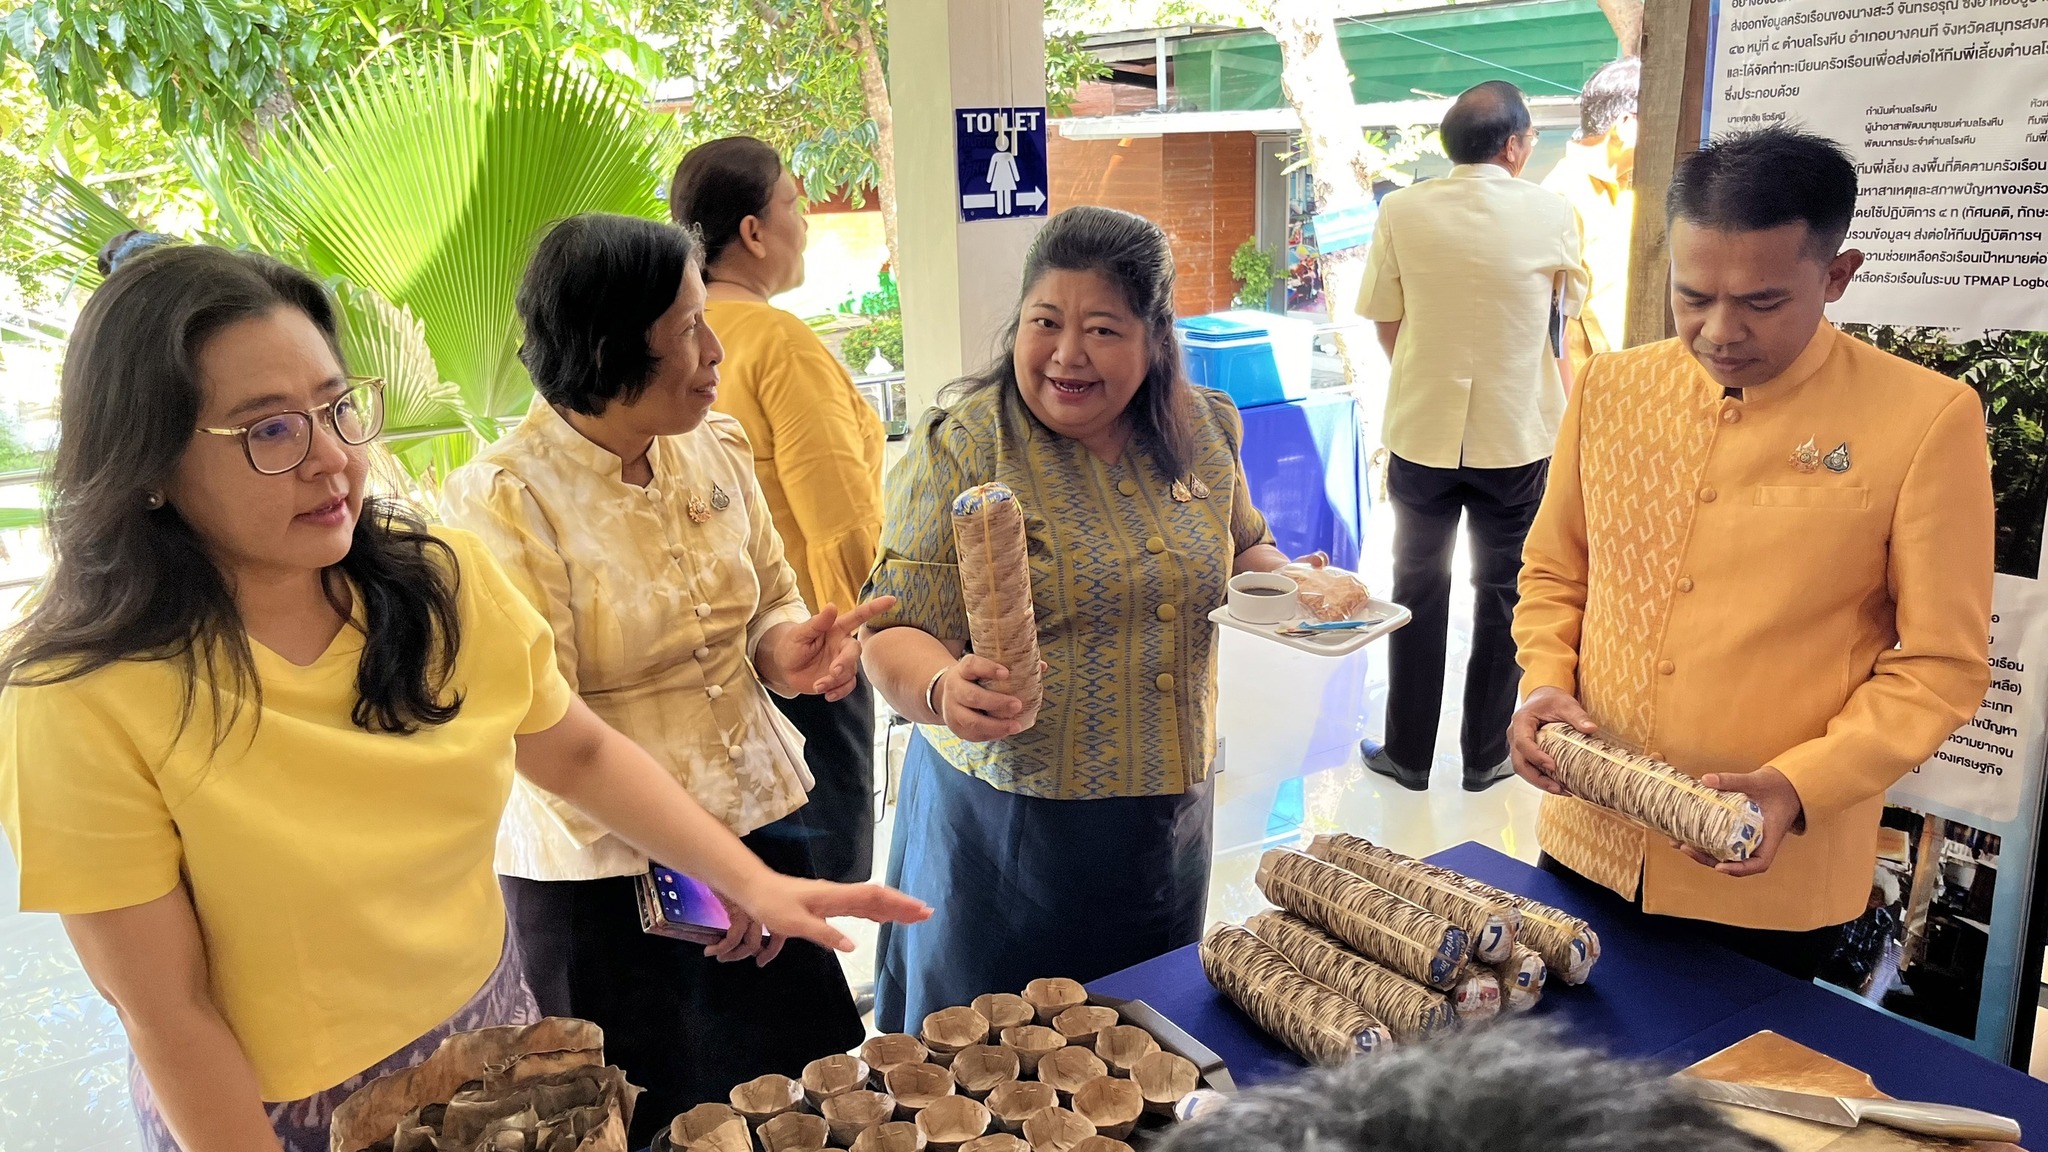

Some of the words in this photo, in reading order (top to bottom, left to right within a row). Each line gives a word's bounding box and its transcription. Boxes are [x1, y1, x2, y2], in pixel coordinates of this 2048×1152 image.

[1747, 35, 1769, 56] หมู่ที่
[1783, 32, 1846, 50] ตำบลโรงหีบ
[1850, 24, 1939, 44] อำเภอบางคนที
[1725, 84, 1800, 101] ซึ่งประกอบด้วย
[1866, 104, 1938, 116] กำนันตำบลโรงหีบ
[962, 112, 1040, 133] TOILET
[1853, 205, 1936, 220] ดยใช้ปฏิบัติการ
[1964, 275, 2010, 286] TPMAP
